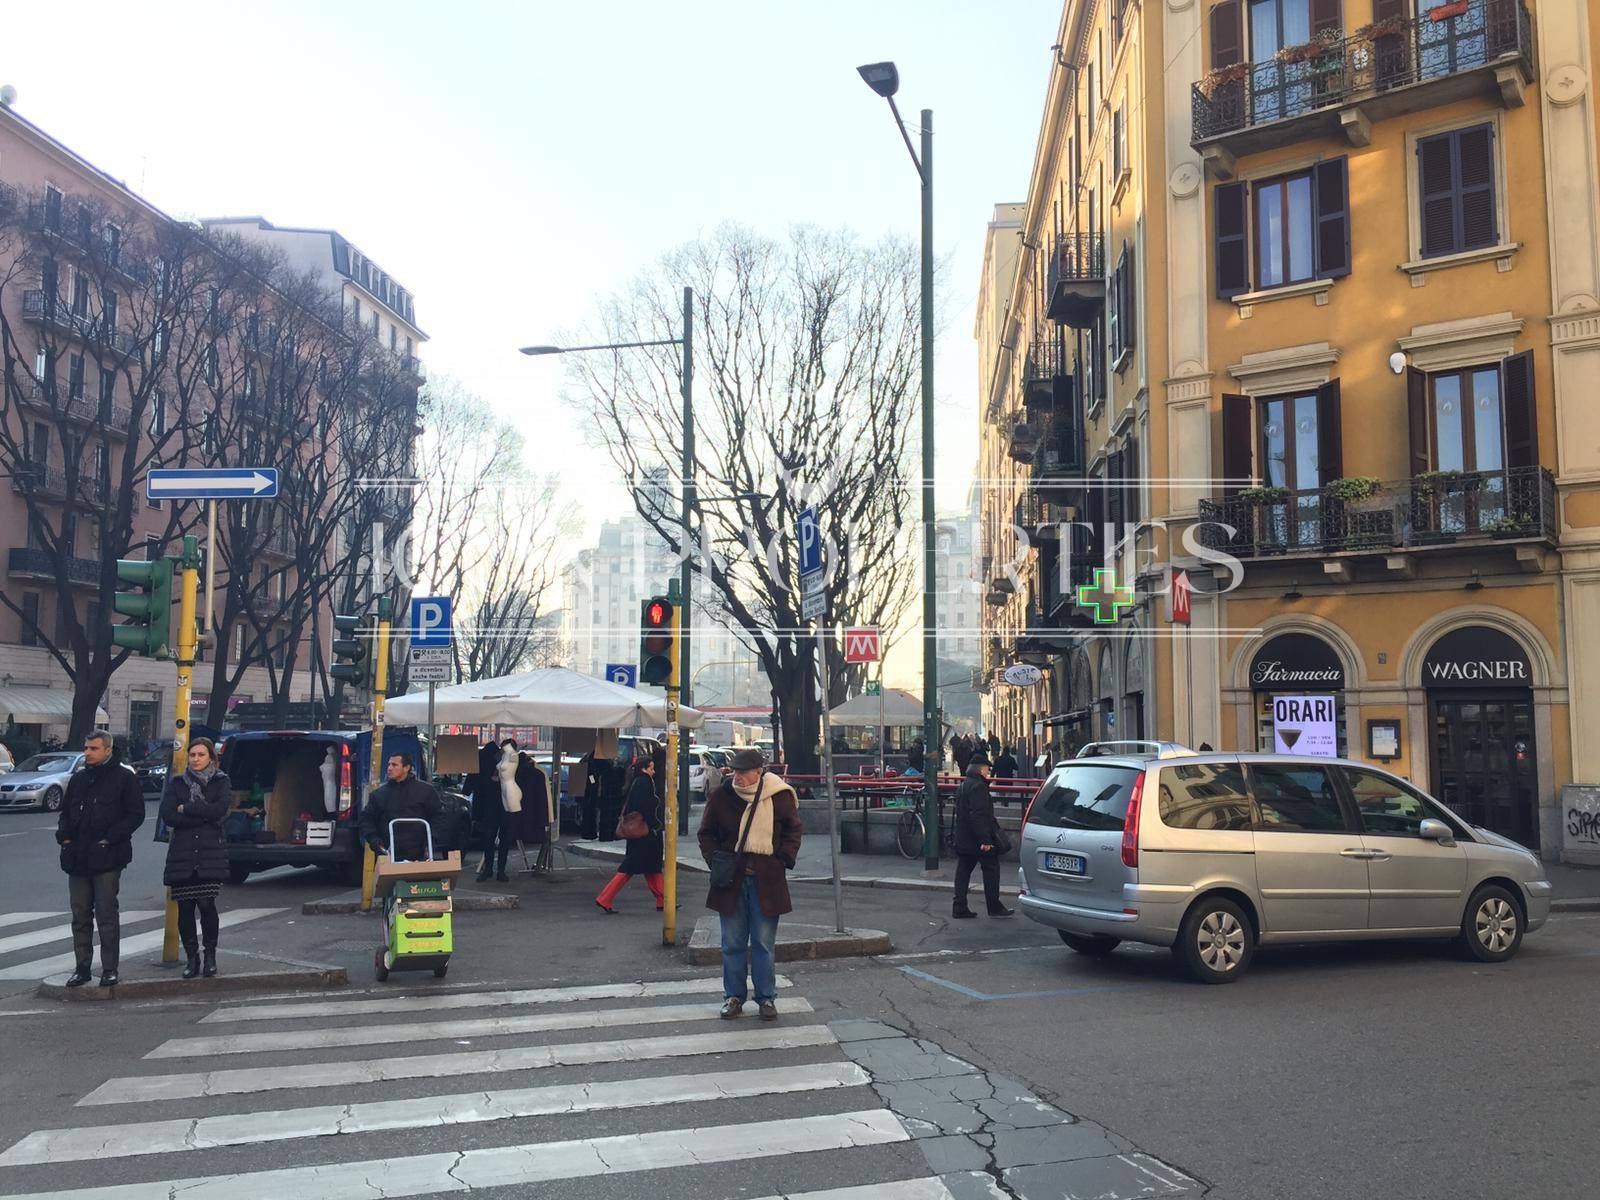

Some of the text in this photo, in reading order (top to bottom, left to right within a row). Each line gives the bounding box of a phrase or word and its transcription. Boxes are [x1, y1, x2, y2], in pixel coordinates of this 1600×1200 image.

[801, 515, 815, 568] P
[1173, 583, 1189, 613] M
[419, 603, 442, 640] P
[848, 635, 876, 656] M
[1252, 660, 1528, 684] Farmacia WAGNER
[1276, 699, 1333, 722] ORARI
